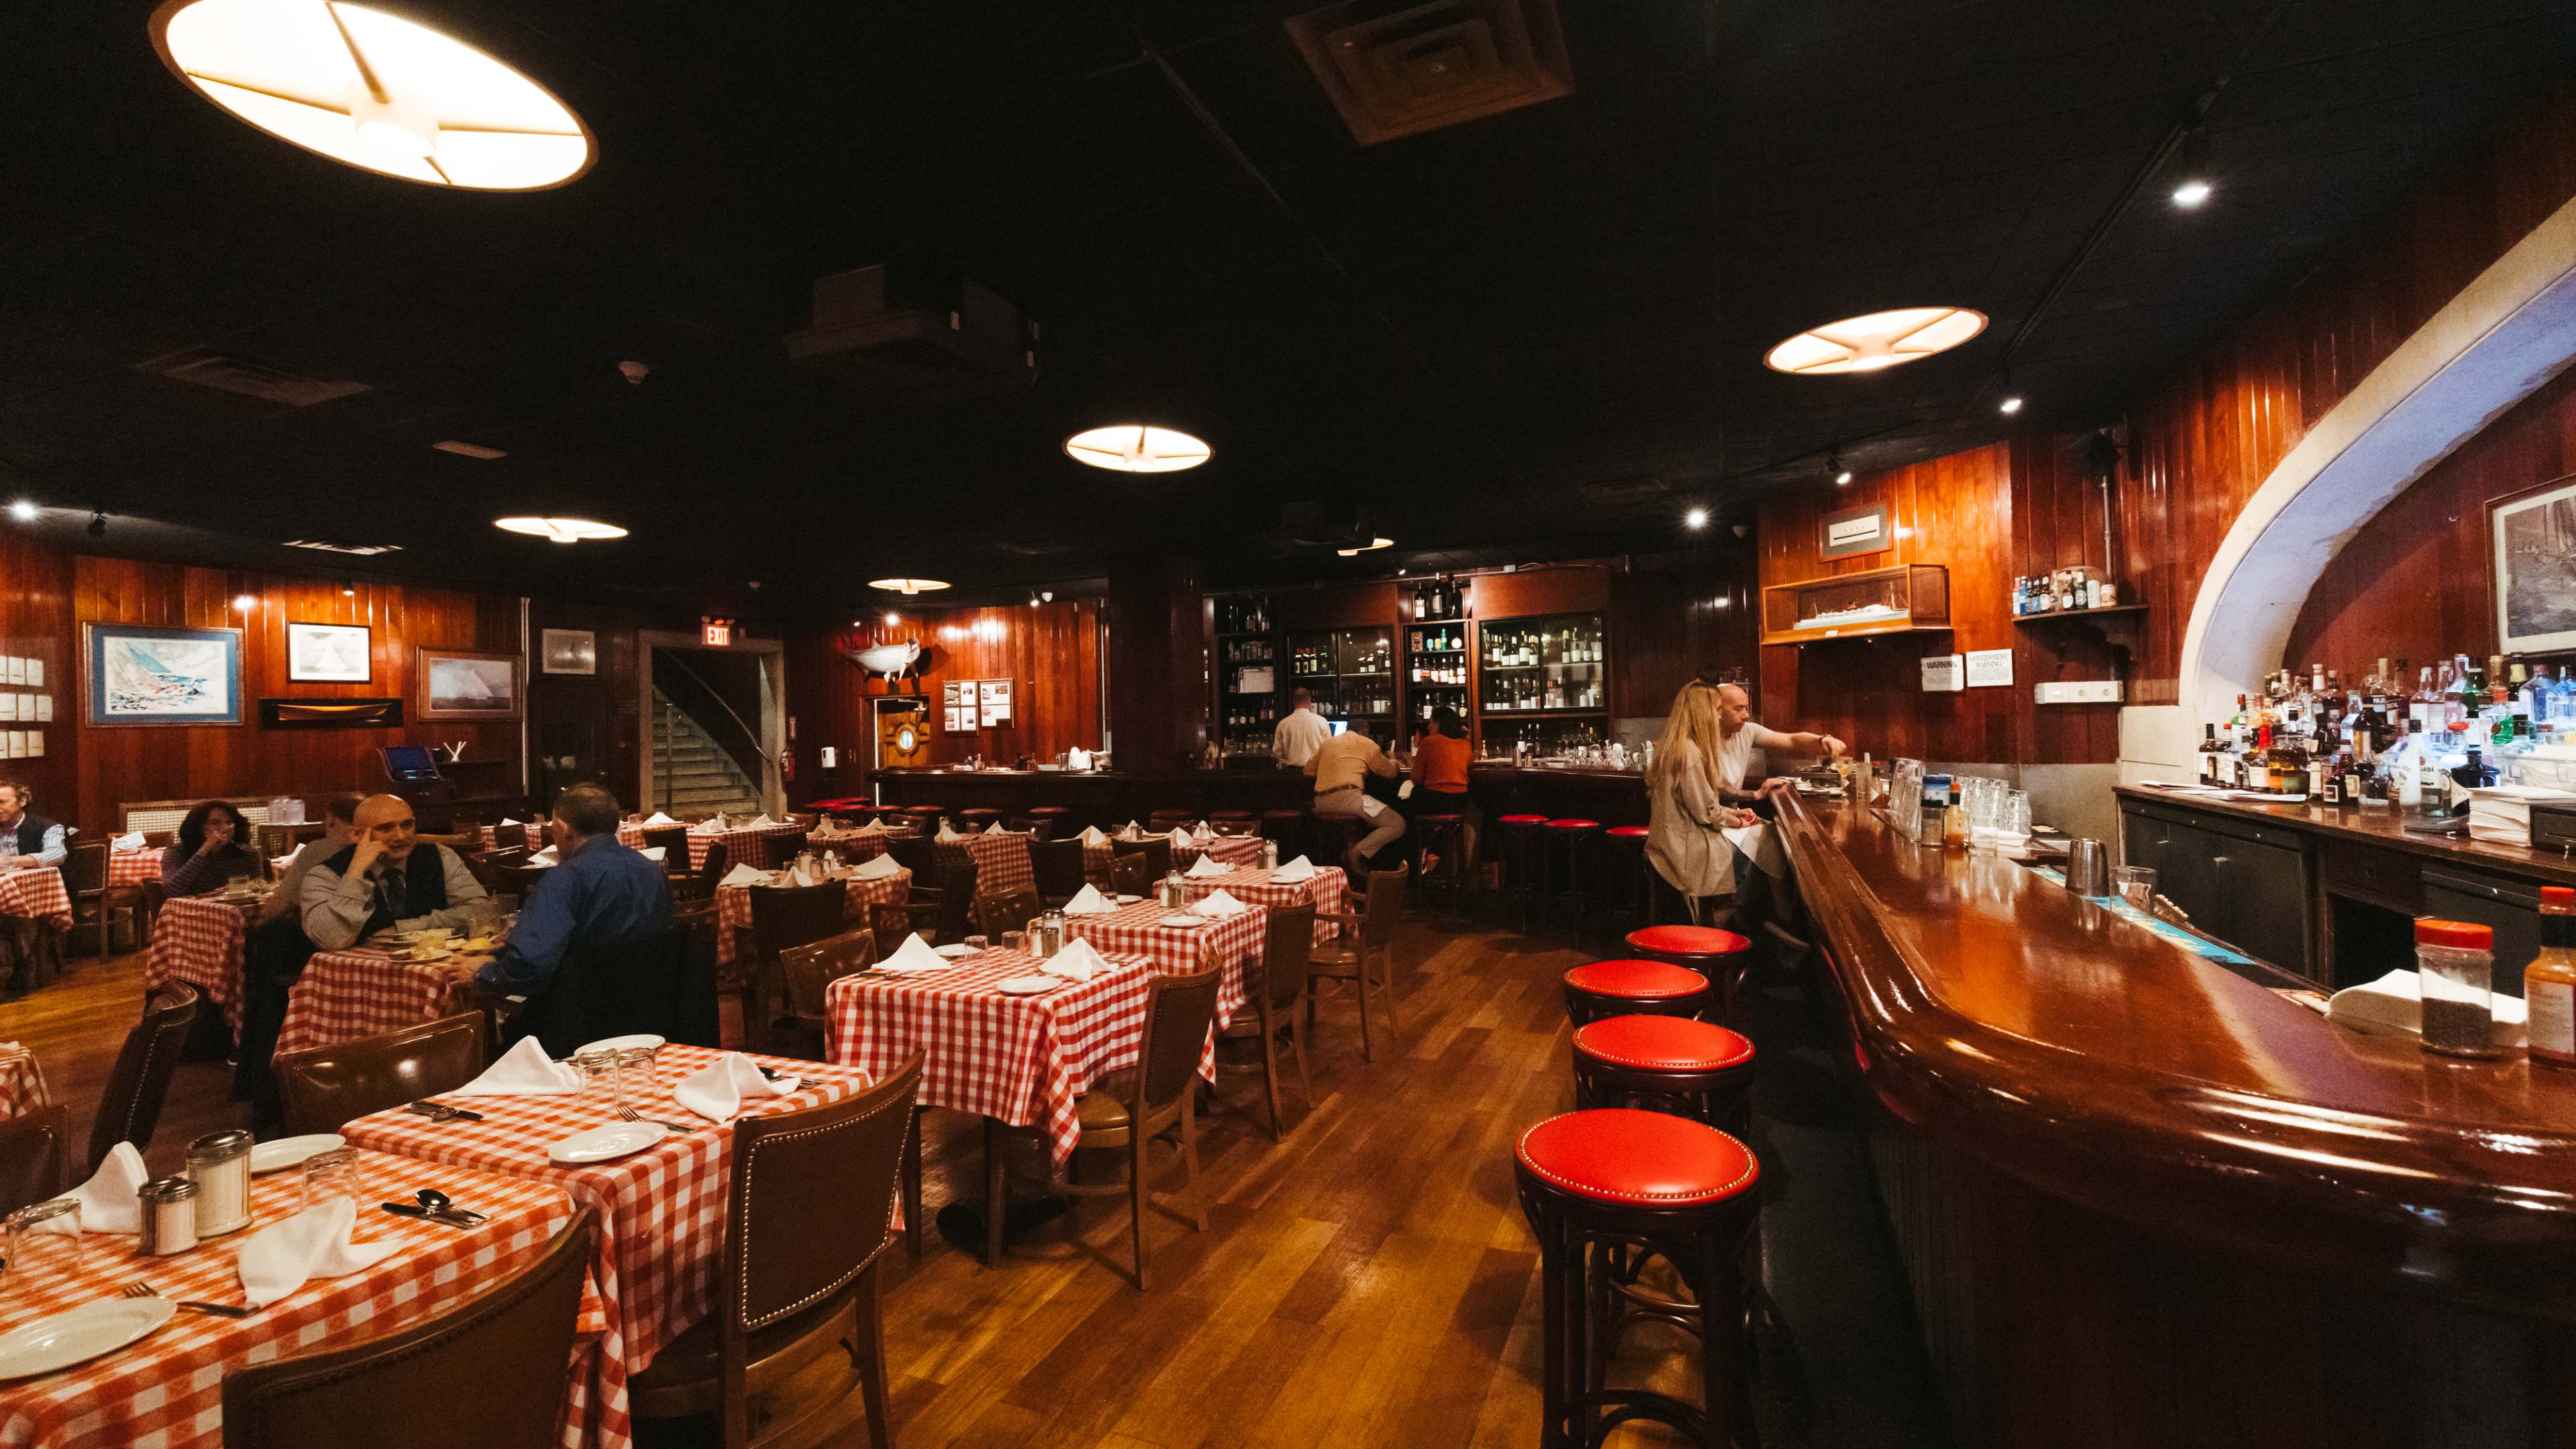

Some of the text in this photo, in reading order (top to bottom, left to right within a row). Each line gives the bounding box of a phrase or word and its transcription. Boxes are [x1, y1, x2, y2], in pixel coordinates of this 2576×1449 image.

[707, 627, 729, 645] EXIT
[1970, 653, 2008, 661] GOVERNMENT
[1926, 660, 1957, 669] WARNING
